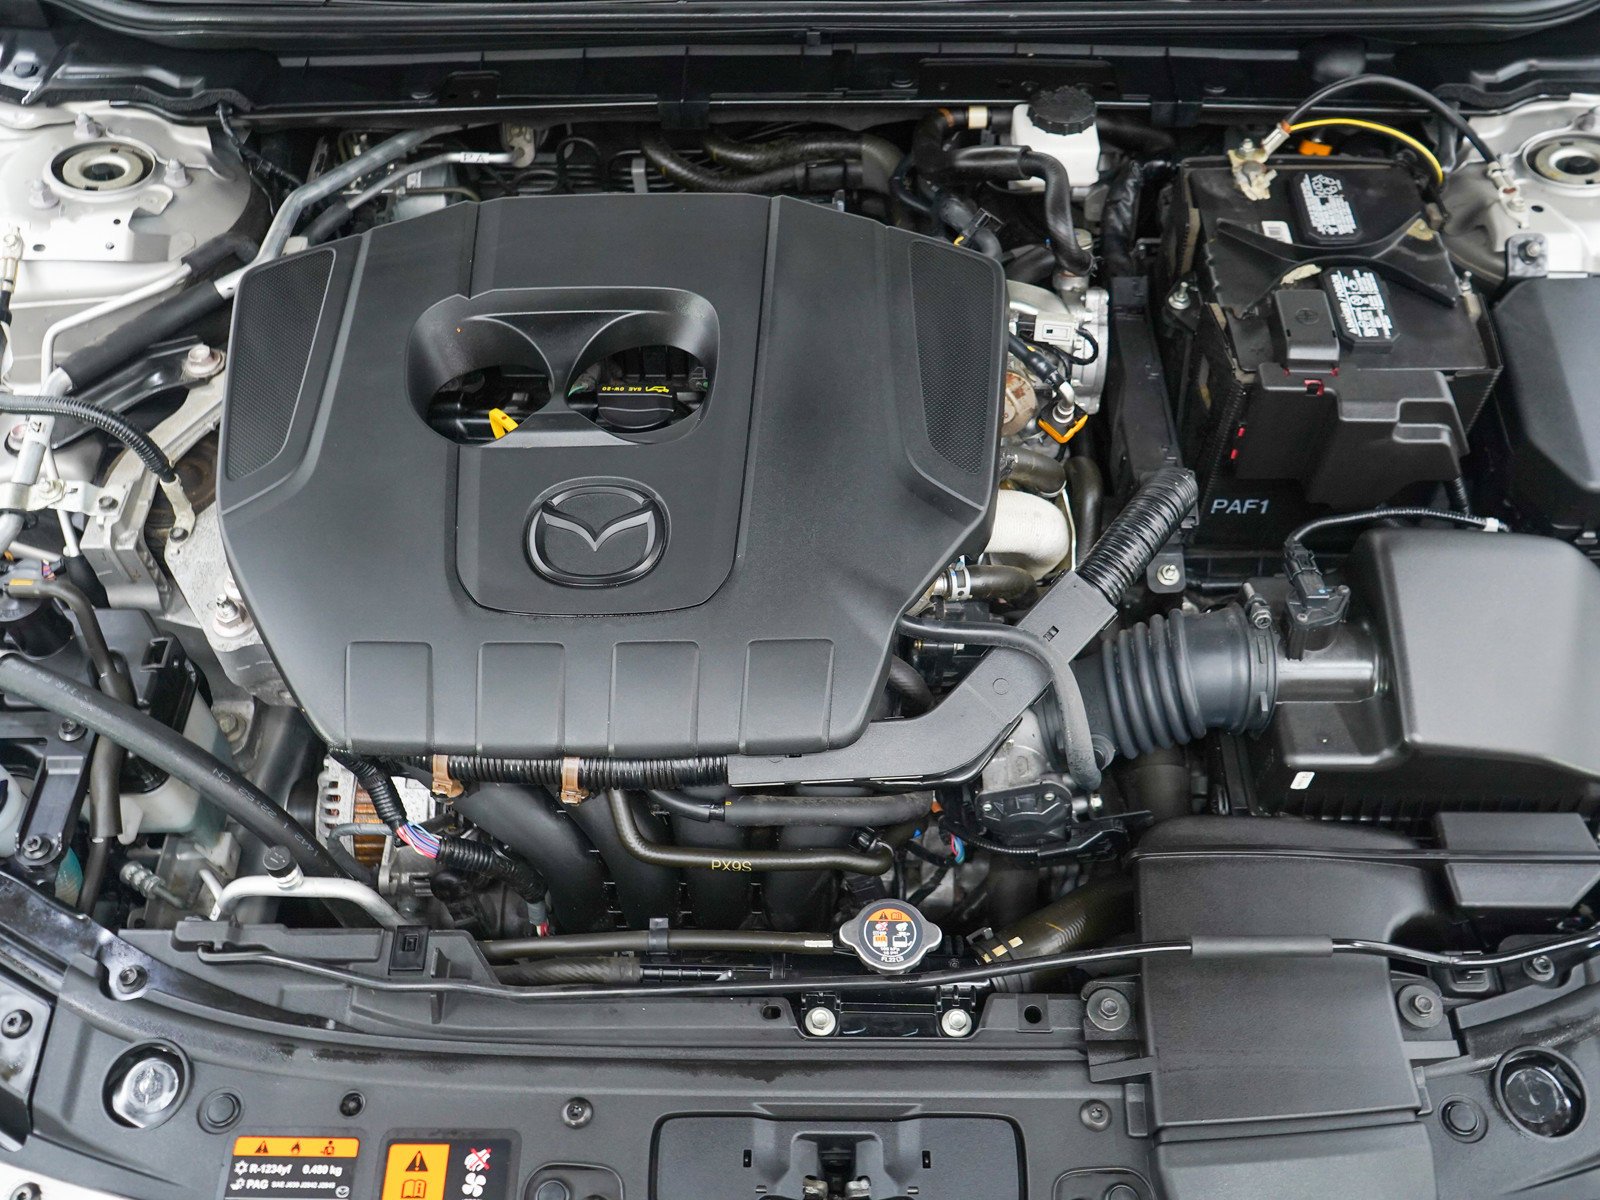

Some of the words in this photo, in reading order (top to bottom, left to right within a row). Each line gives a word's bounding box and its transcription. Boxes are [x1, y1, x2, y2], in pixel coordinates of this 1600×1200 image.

[1210, 498, 1270, 514] PAF1
[711, 859, 752, 872] PX9S
[248, 1163, 293, 1177] R-1234yf
[329, 1165, 343, 1177] kg
[245, 1179, 269, 1190] PAG
